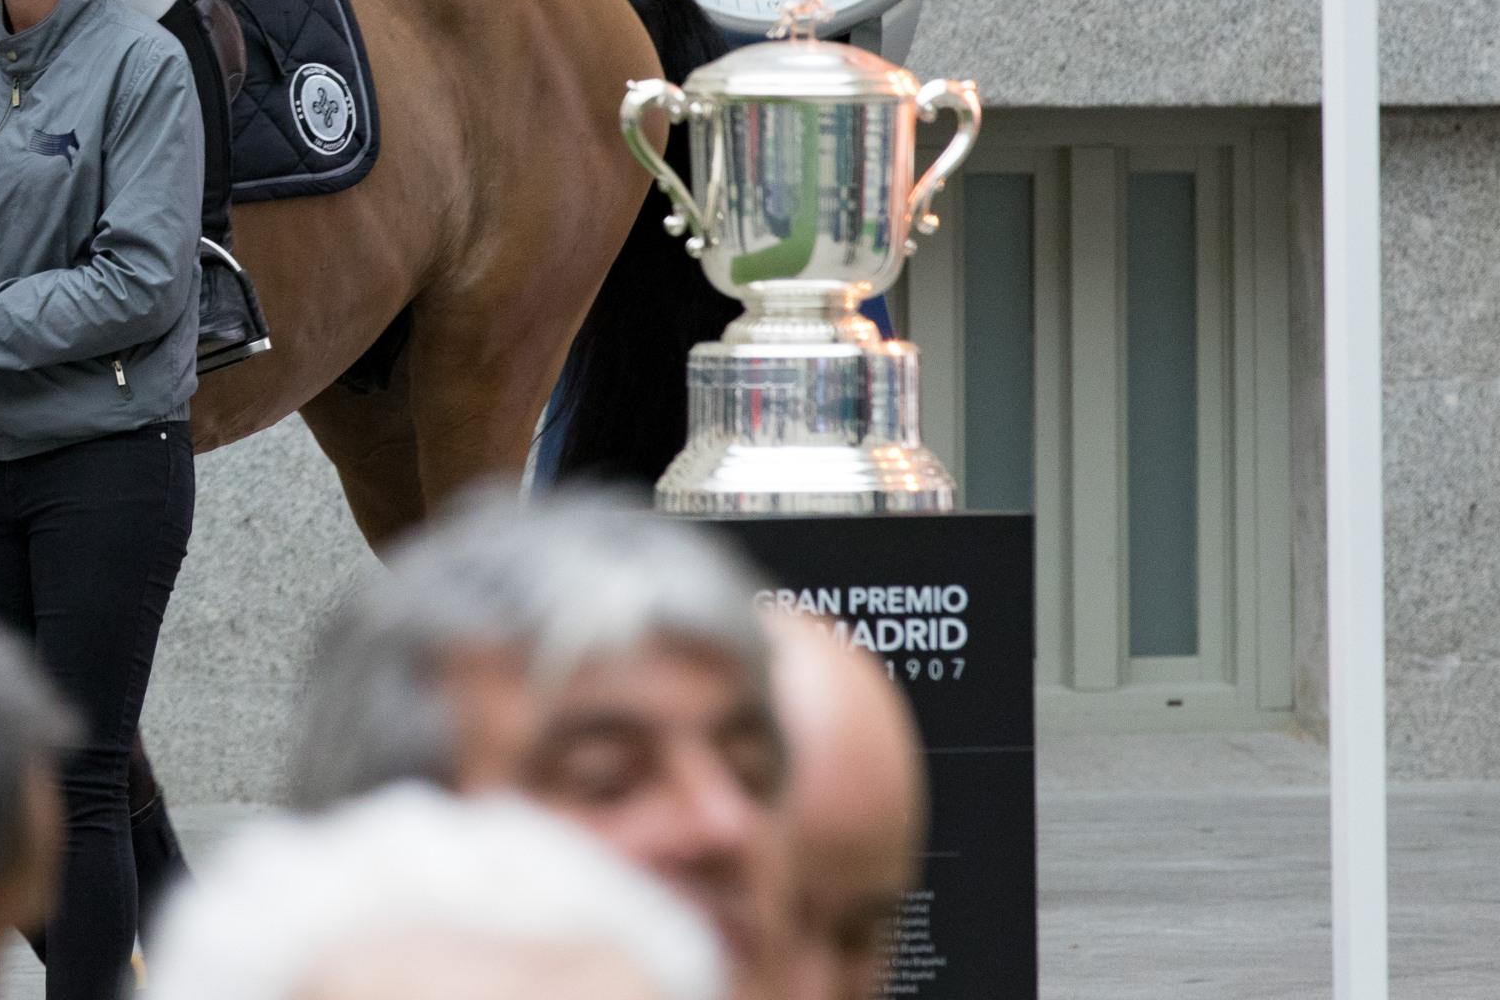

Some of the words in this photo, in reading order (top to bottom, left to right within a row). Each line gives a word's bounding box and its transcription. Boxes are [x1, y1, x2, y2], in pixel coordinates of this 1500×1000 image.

[755, 588, 841, 615] GRAN
[848, 585, 968, 614] PREMIO
[886, 658, 966, 681] 1907
